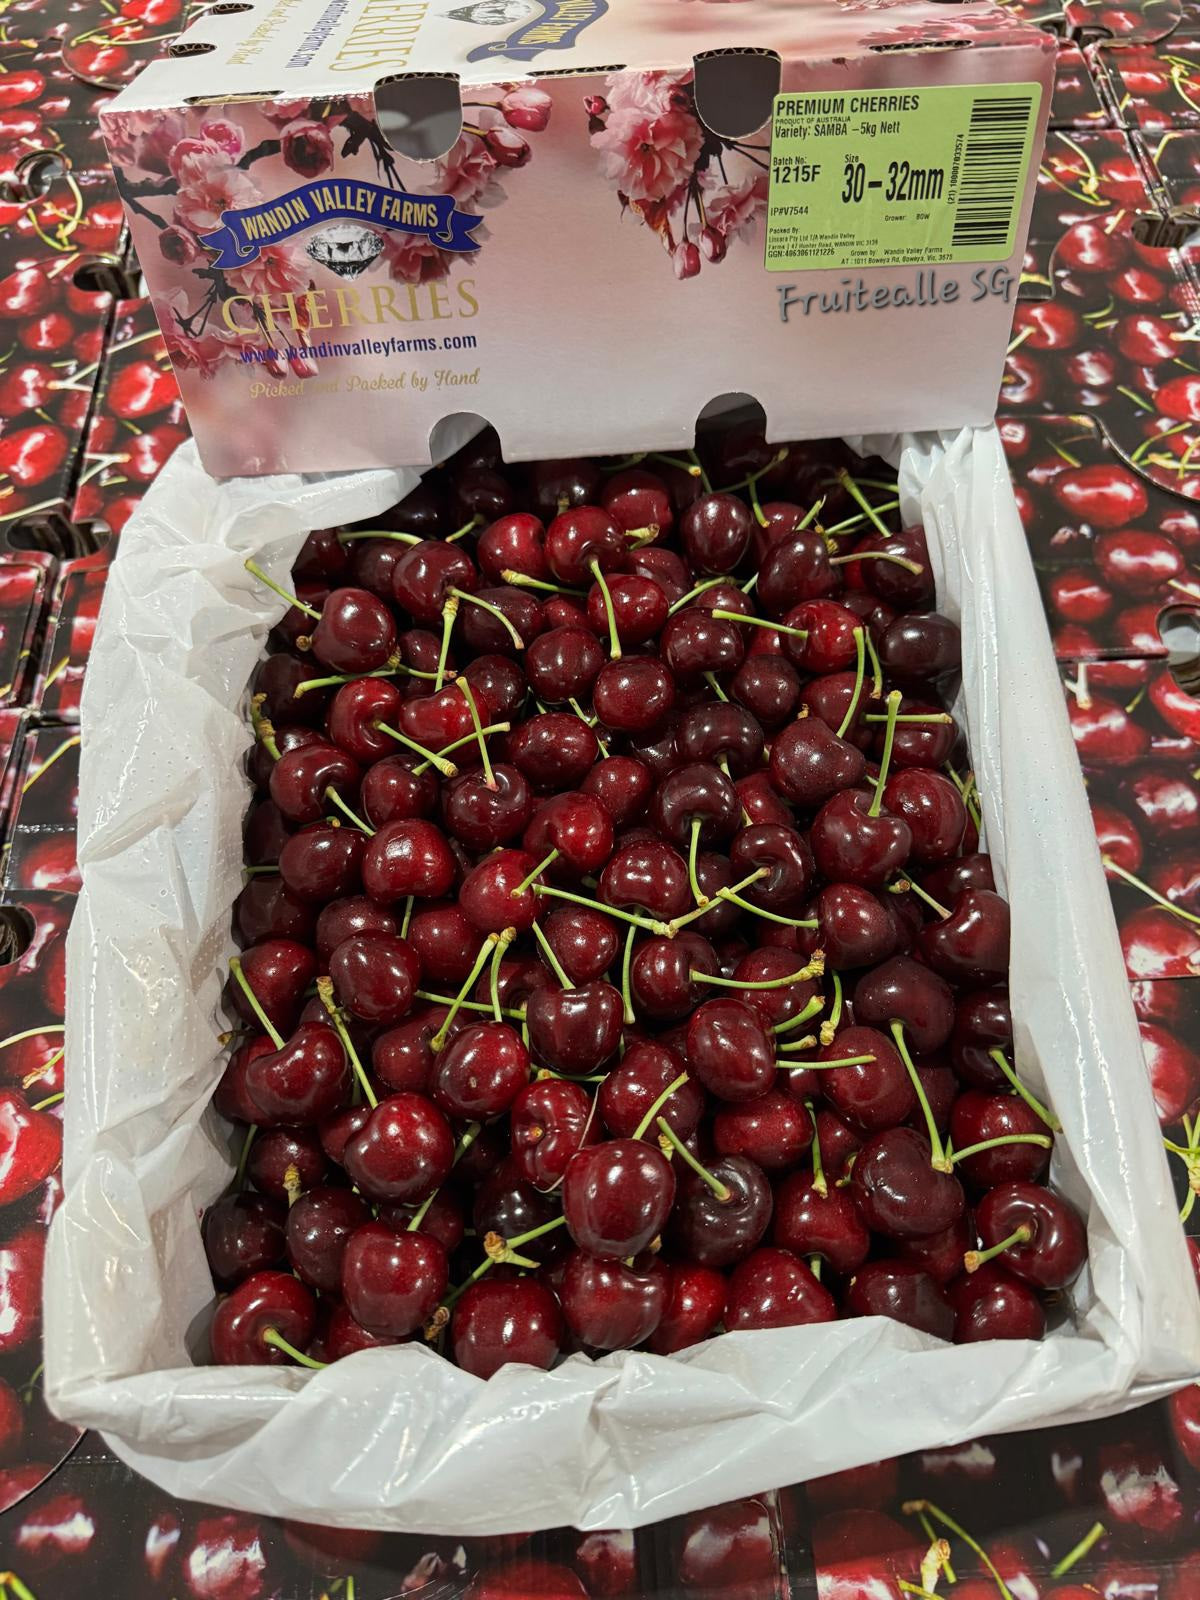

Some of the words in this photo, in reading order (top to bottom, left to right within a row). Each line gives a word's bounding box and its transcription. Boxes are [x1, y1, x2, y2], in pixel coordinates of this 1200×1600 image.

[328, 0, 430, 71] ERRIES
[776, 98, 845, 116] PREMIUM
[850, 95, 920, 113] CHERRIES
[775, 125, 811, 140] Variety:
[814, 123, 848, 137] SAMBA
[880, 121, 900, 134] Nett
[773, 157, 793, 166] Batch
[844, 153, 860, 163] Size
[772, 164, 821, 184] 1215F
[241, 196, 310, 241] WANDIN
[309, 185, 377, 213] VALLEY
[380, 196, 439, 228] FARMS
[222, 278, 480, 336] CHERRIES
[240, 333, 477, 365] www.wandinvalleyfarms.com
[249, 379, 304, 399] Picked
[347, 370, 407, 393] Packed
[411, 369, 429, 391] by
[434, 366, 481, 387] Hand
